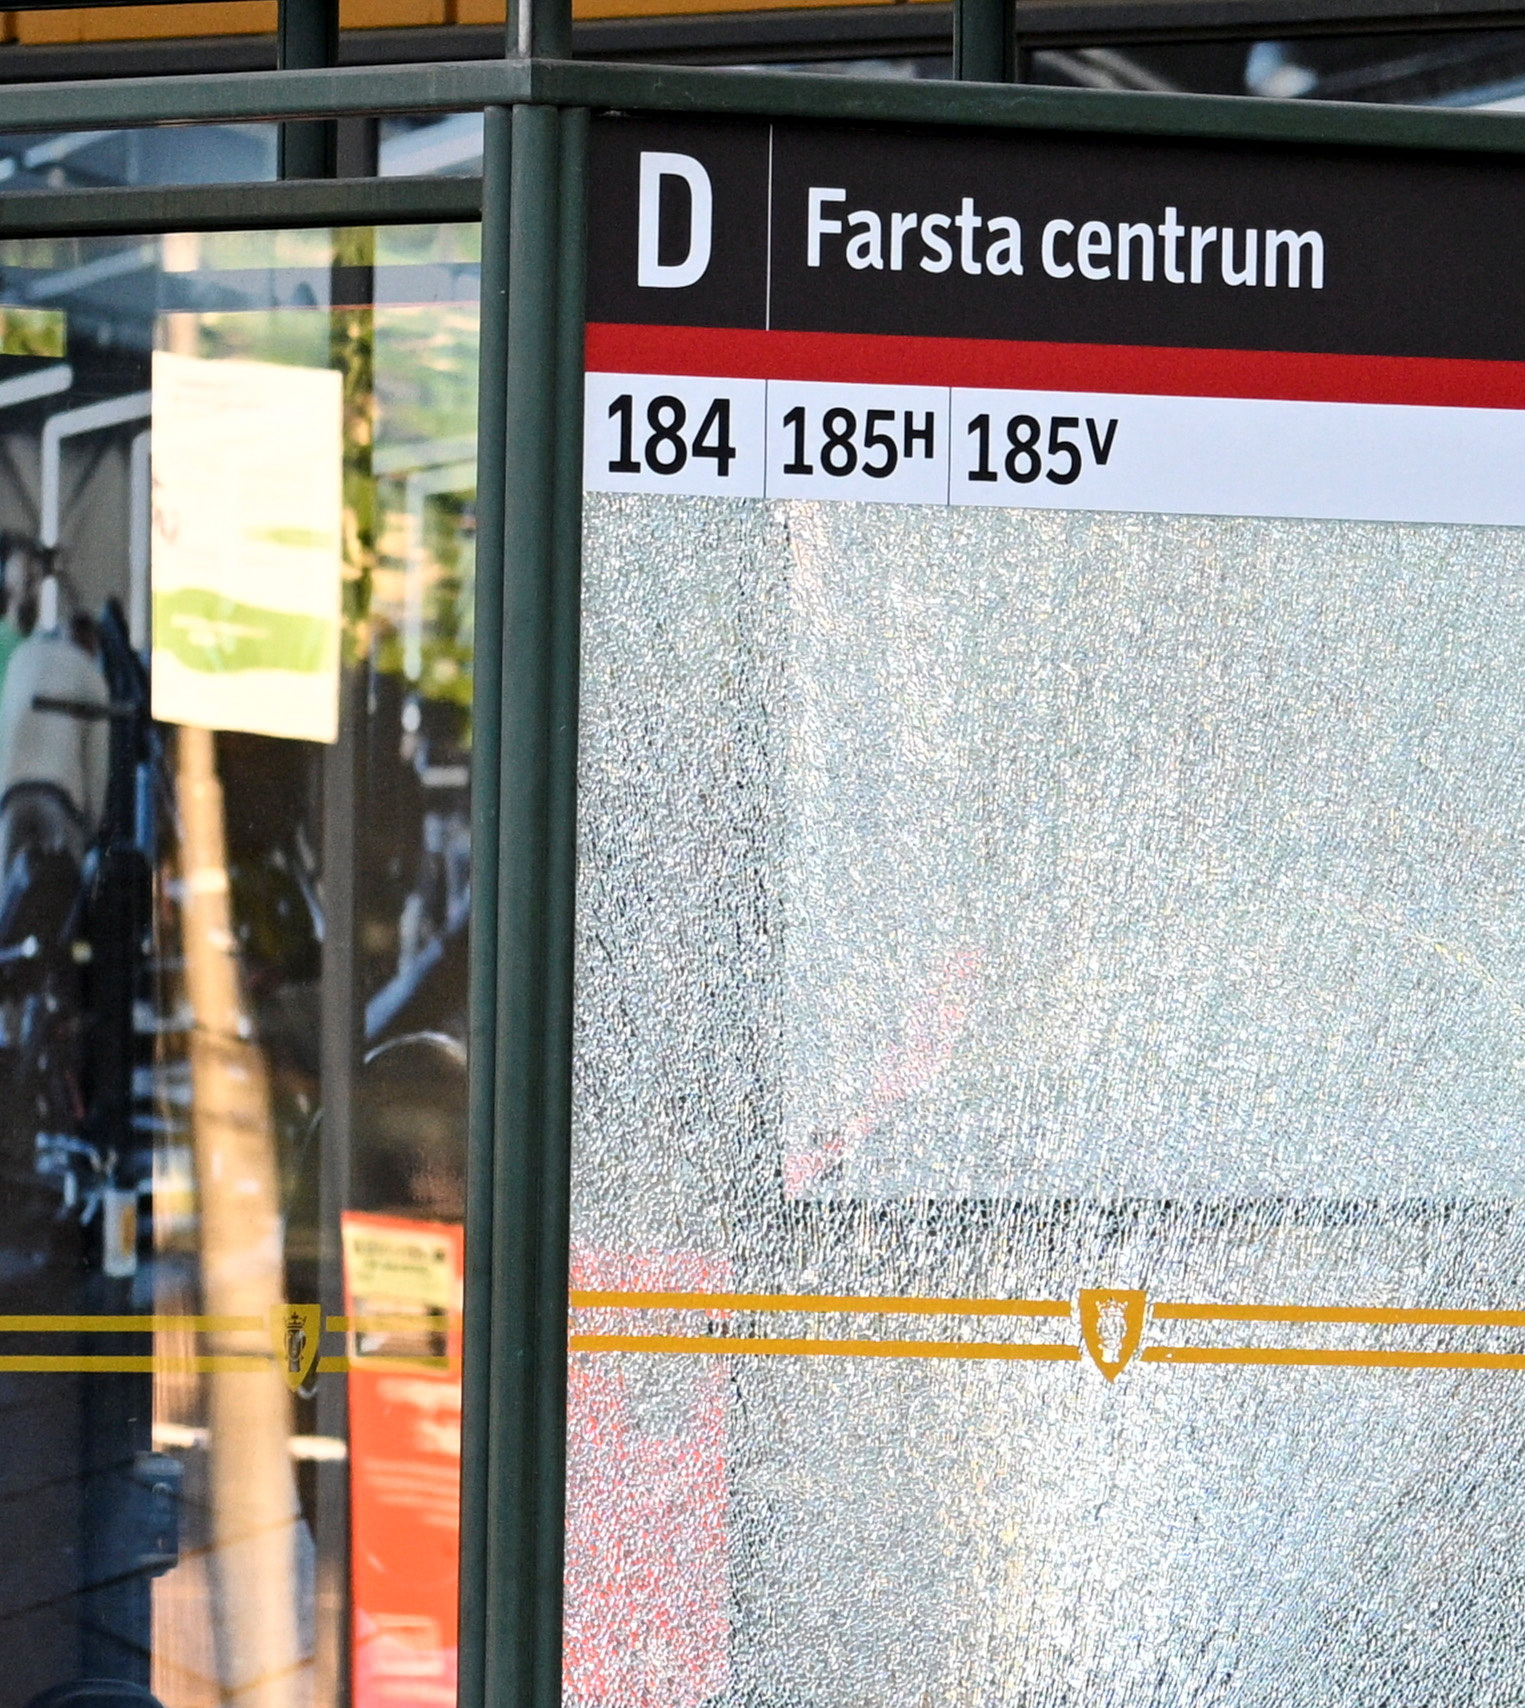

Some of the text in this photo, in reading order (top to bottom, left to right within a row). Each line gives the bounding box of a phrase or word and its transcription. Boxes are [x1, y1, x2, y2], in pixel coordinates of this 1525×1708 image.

[637, 151, 713, 289] D
[807, 186, 1324, 290] Farsta centrum
[608, 394, 736, 477] 184
